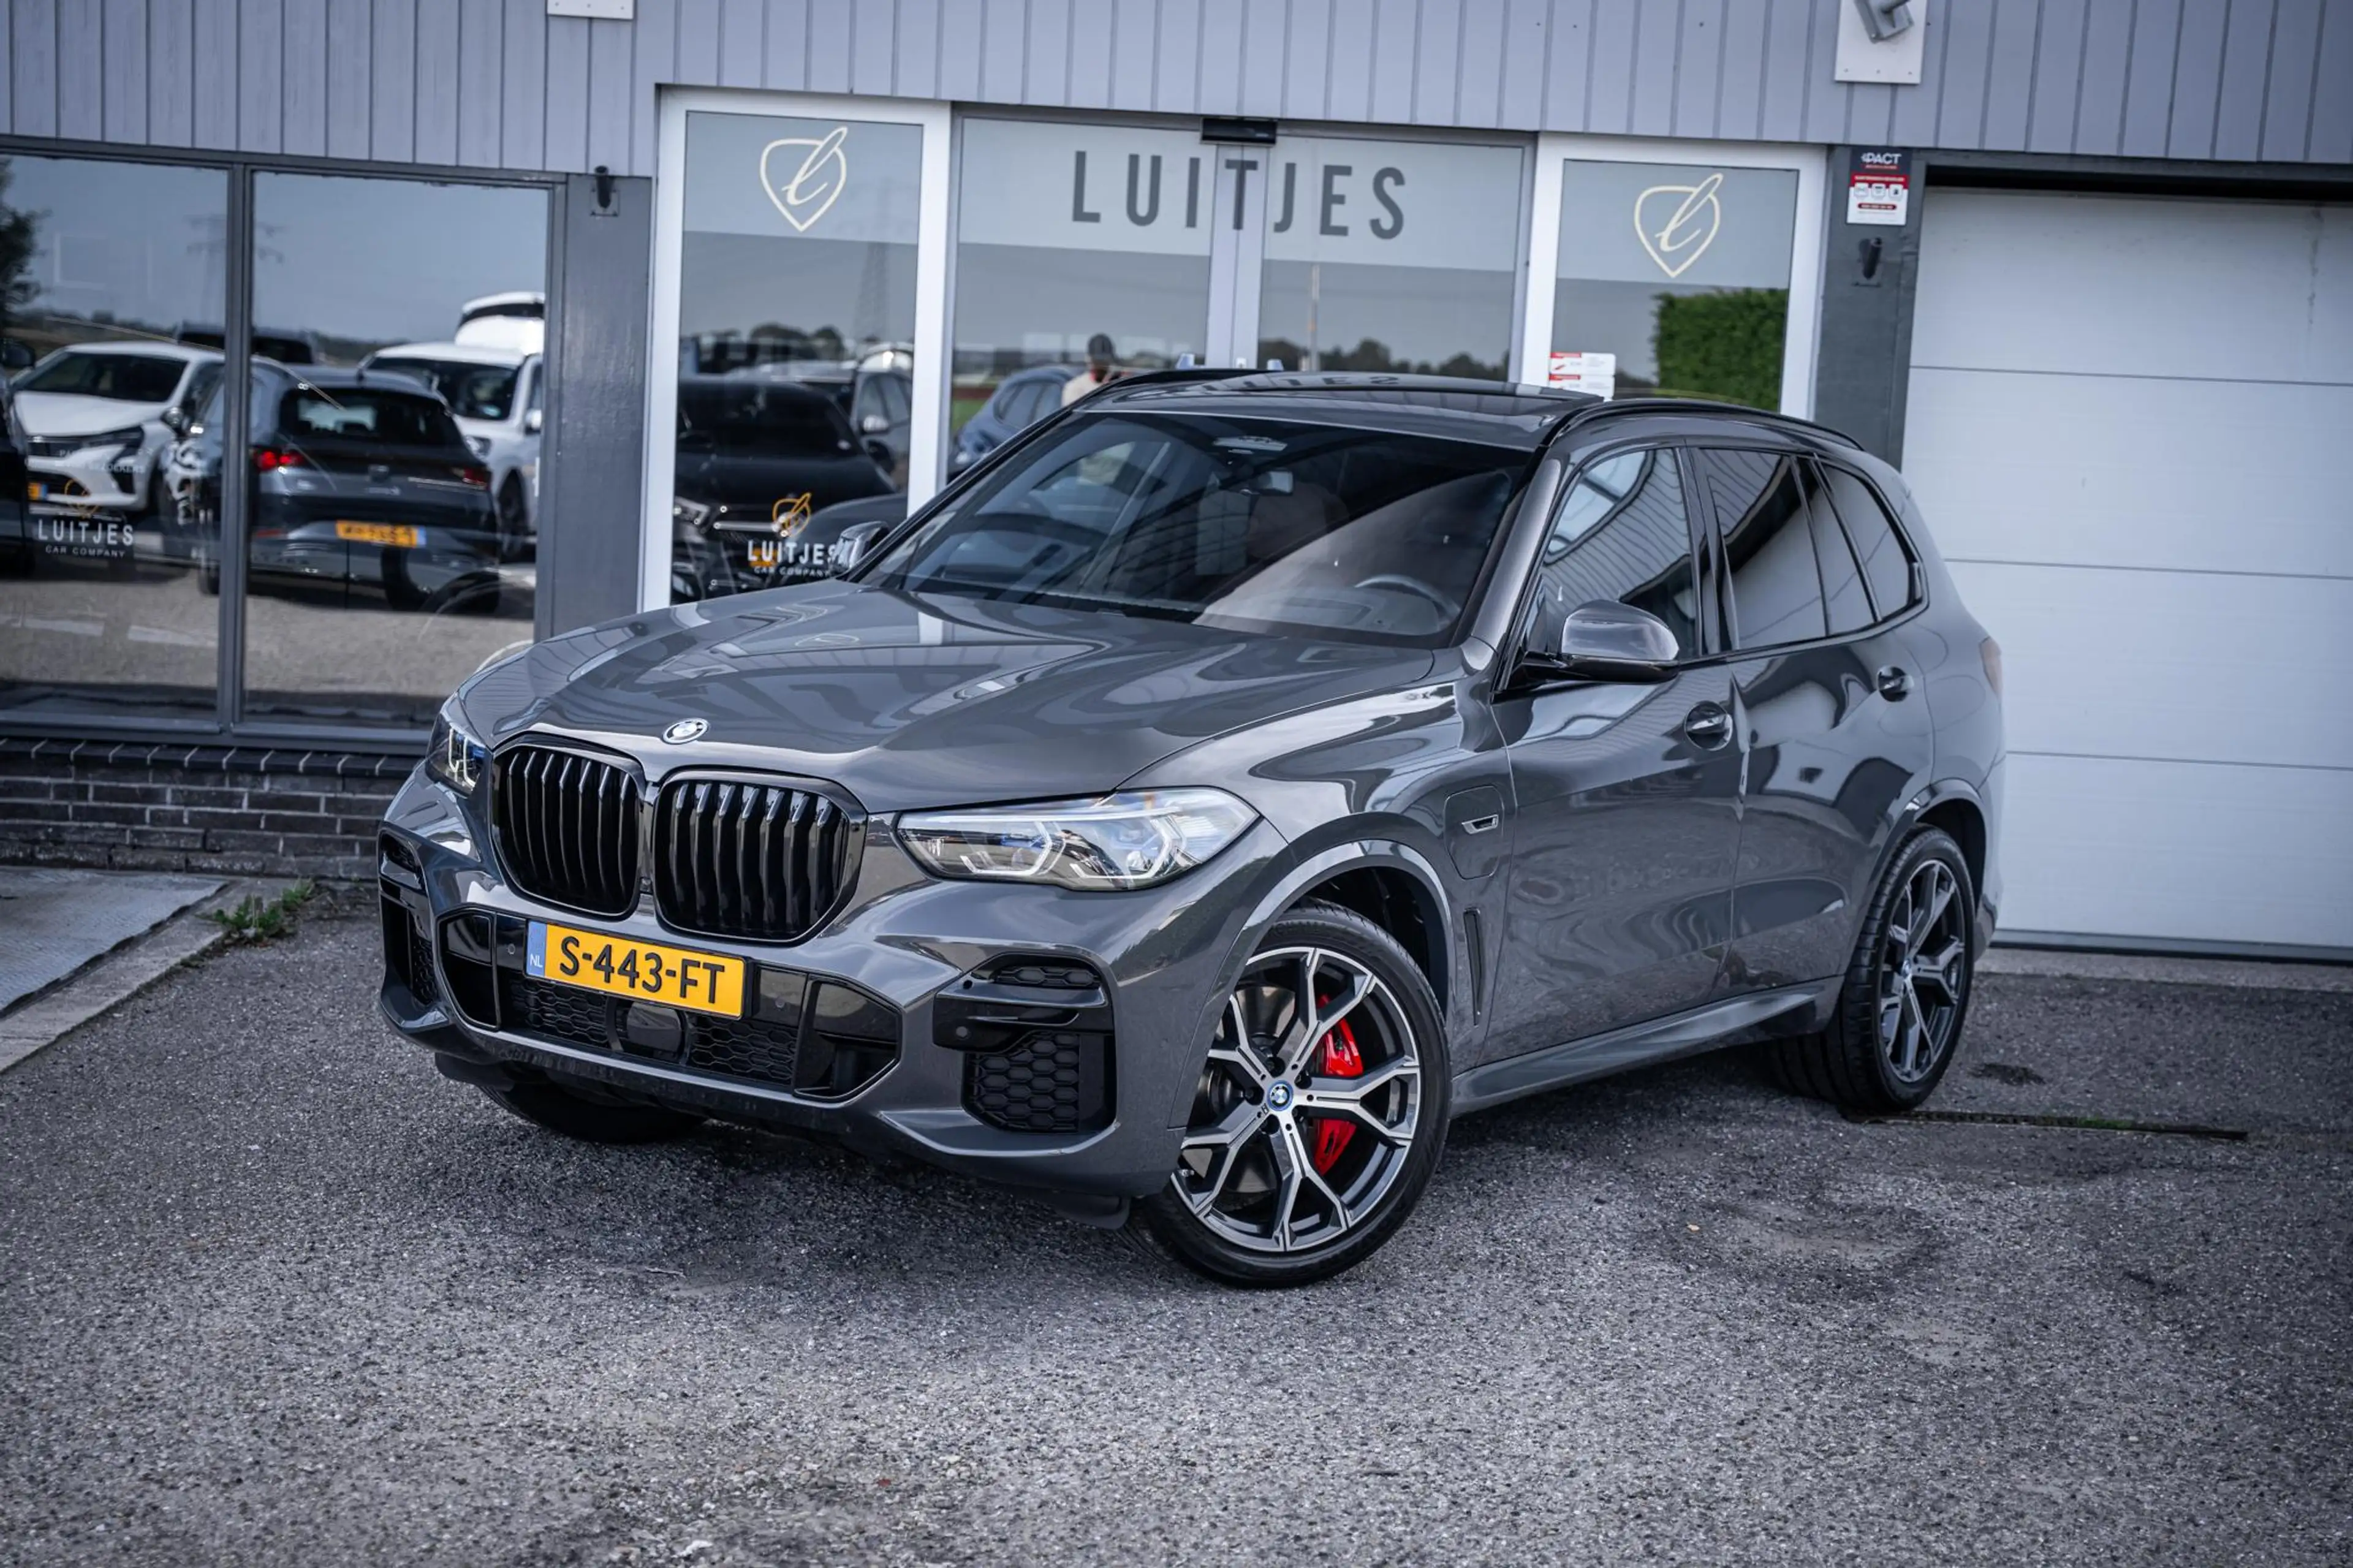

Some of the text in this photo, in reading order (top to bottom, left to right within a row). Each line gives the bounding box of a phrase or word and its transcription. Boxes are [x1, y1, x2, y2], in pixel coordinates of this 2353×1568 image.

[1072, 150, 1406, 240] LUITJES
[37, 519, 134, 546] LUITJES
[45, 544, 126, 558] CAR COMPANY
[529, 936, 726, 1004] NL S-443-FT
